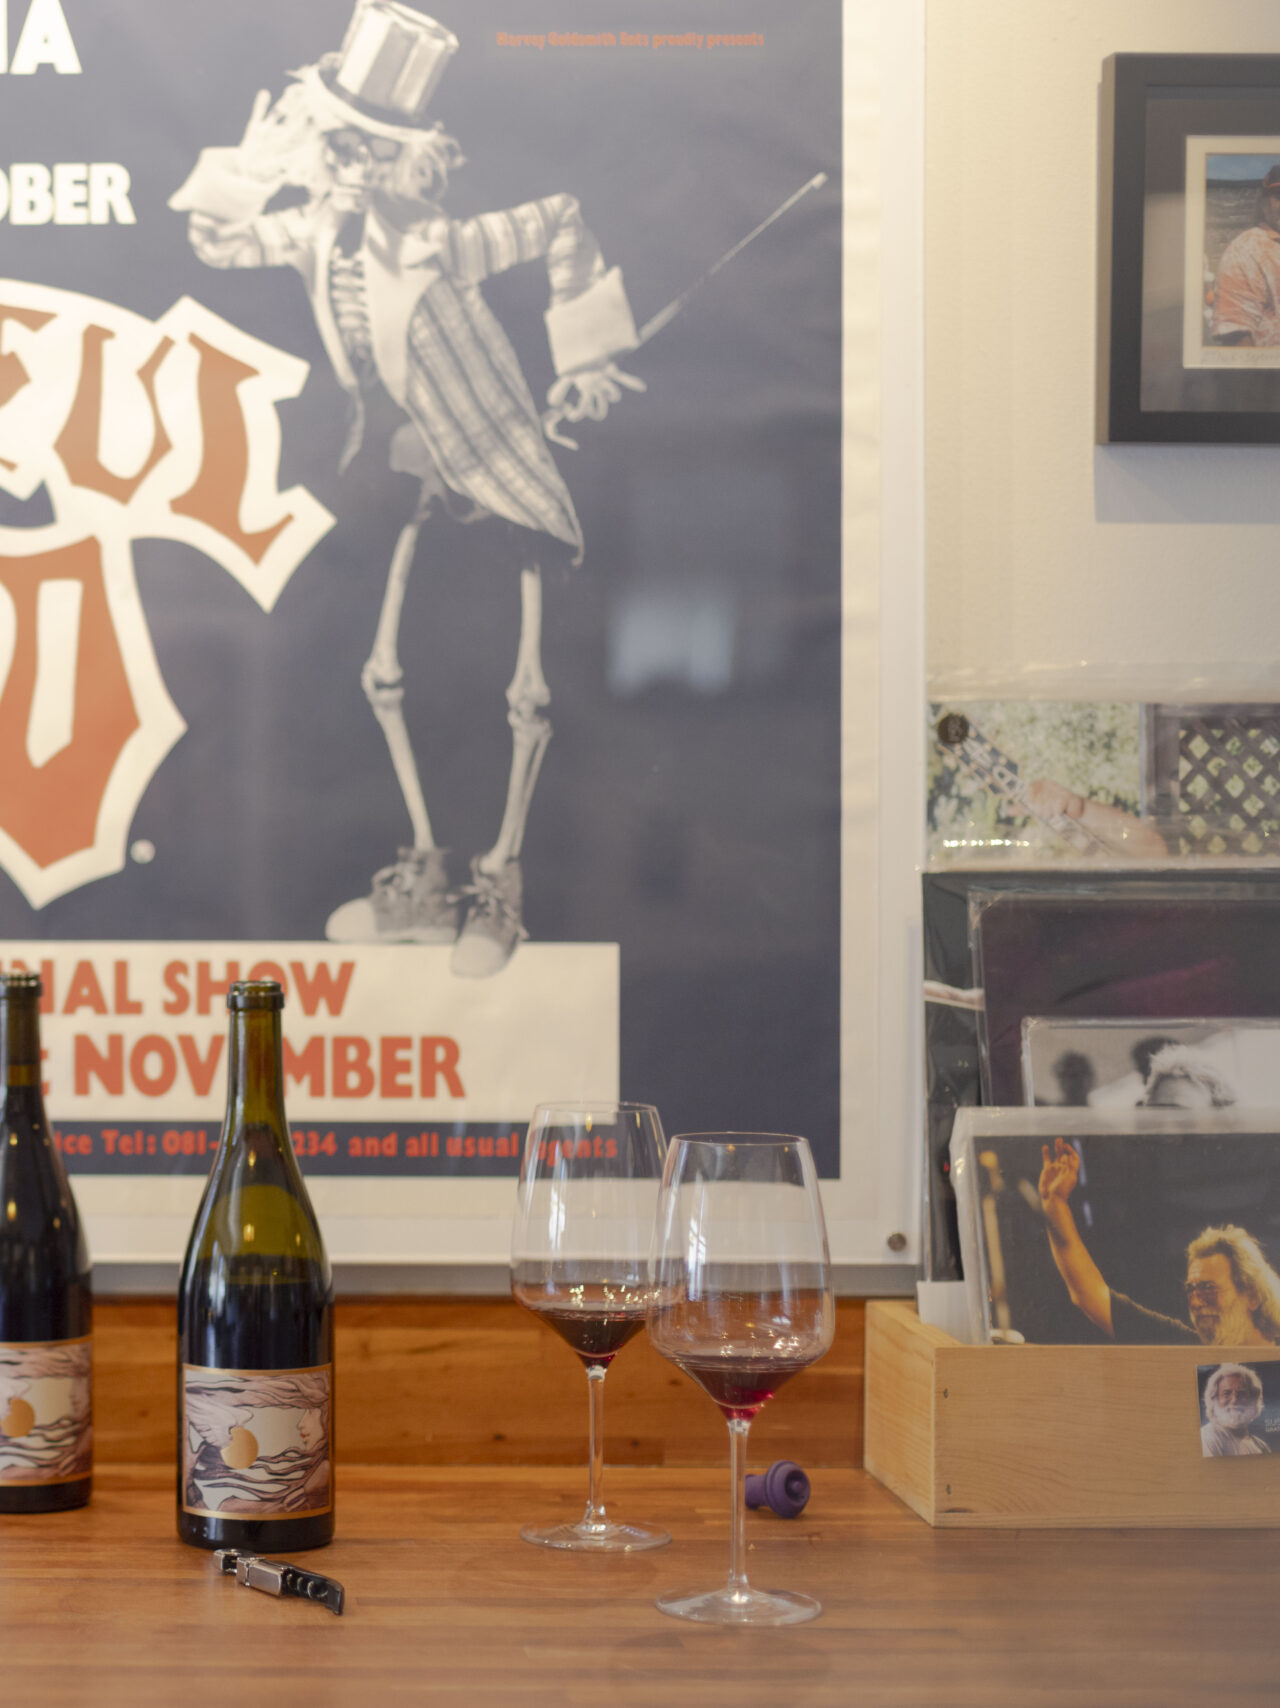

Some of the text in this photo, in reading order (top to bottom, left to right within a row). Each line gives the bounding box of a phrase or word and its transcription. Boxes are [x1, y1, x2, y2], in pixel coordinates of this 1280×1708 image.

[652, 32, 703, 49] proudly
[706, 33, 764, 49] presents
[73, 1032, 466, 1099] NOVMBER
[100, 1129, 157, 1156] Tel:
[348, 1131, 398, 1158] and
[405, 1132, 439, 1158] all
[445, 1132, 519, 1158] usual
